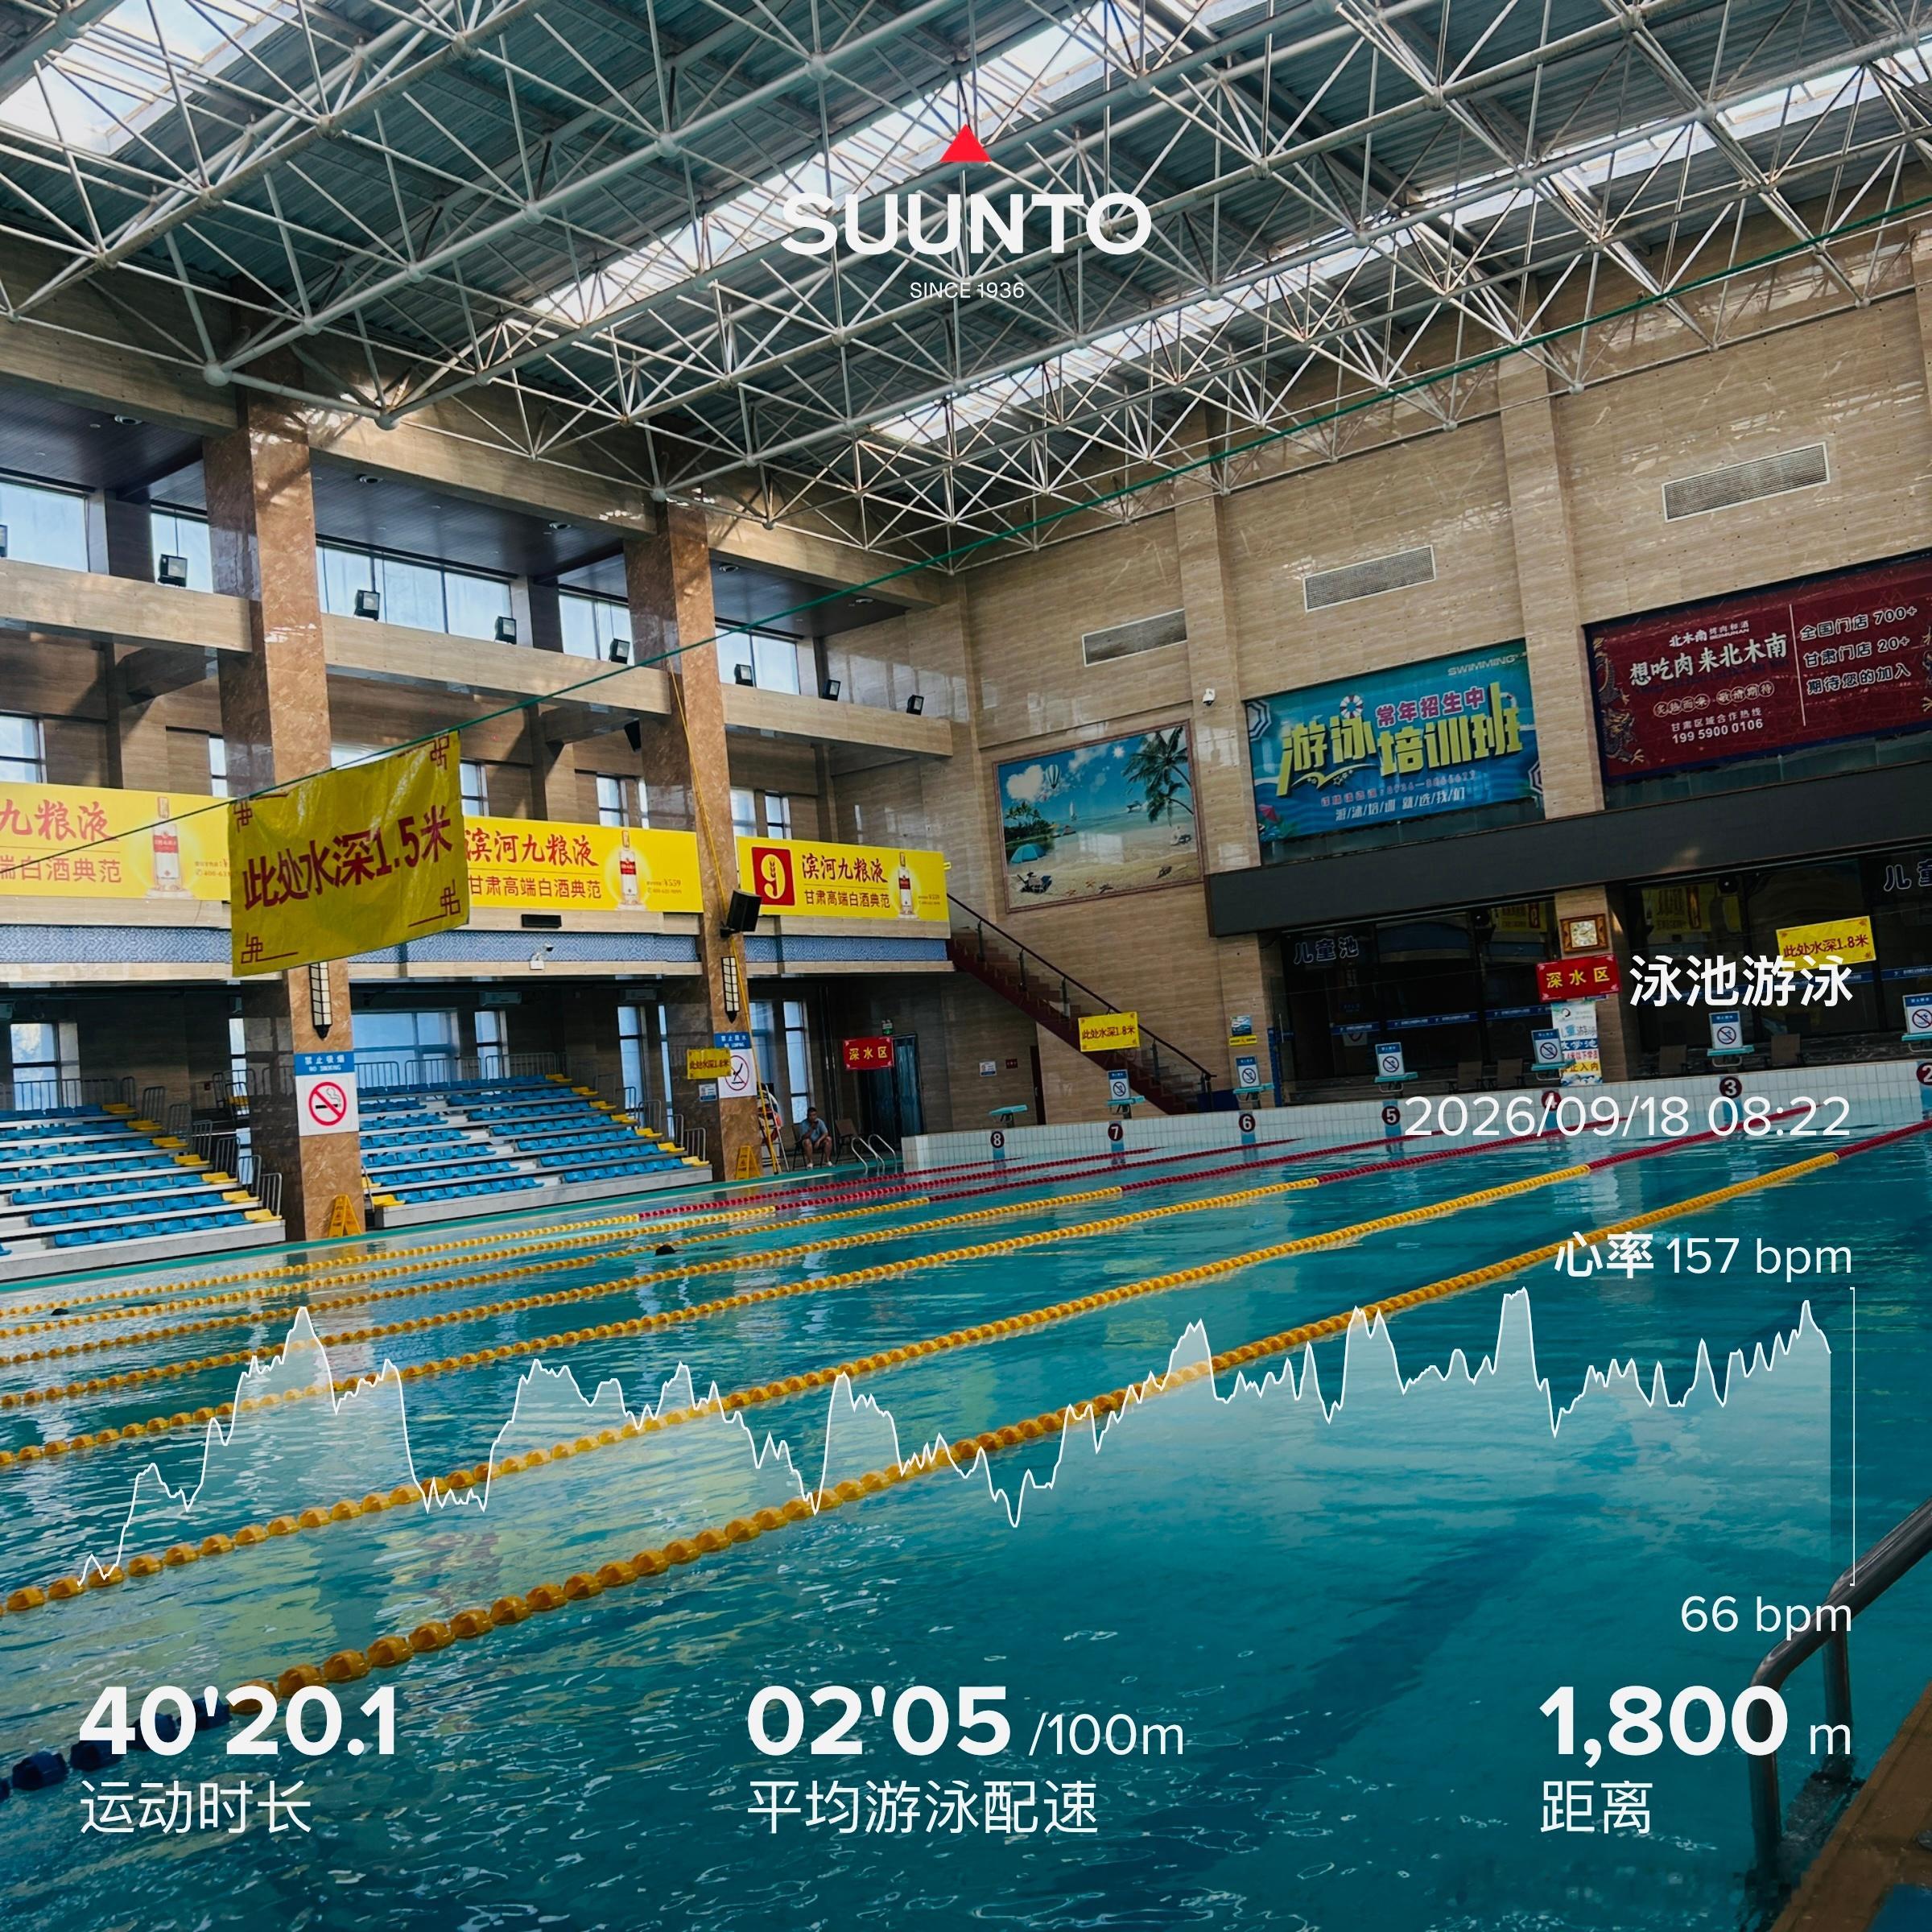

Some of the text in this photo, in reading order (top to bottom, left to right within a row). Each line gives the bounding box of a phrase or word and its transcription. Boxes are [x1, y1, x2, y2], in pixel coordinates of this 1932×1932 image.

[1800, 605, 1918, 641] 全国门店 700+
[1669, 630, 1707, 647] 北木南
[1629, 632, 1787, 687] 想吃肉 来北木南
[1803, 636, 1910, 668] 甘肃门店 20+
[1447, 654, 1516, 676] SWIMMING
[1806, 663, 1911, 695] 期待您的加入
[1375, 686, 1485, 728] 常年招生中
[1276, 682, 1523, 796] 游泳培训班
[1672, 718, 1763, 745] 199 5900 0106
[0, 799, 119, 842] 九粮液
[244, 805, 453, 910] 此处水深1.5米
[464, 827, 599, 867] 滨河九粮液
[802, 852, 889, 883] 滨河九粮液
[469, 875, 602, 899] 甘肃高端白酒典范
[804, 890, 890, 909] 甘肃高端白酒典范
[1294, 935, 1359, 964] 儿童池
[1783, 934, 1869, 958] 此处水深1.8米
[1546, 966, 1610, 989] 深水区
[849, 1046, 888, 1061] 深水区
[1922, 1065, 1932, 1082] 2
[1724, 1080, 1737, 1096] 3
[1242, 1117, 1253, 1130] 6
[1385, 1108, 1397, 1124] 5
[993, 1133, 1002, 1146] 8
[1111, 1126, 1121, 1139] 7
